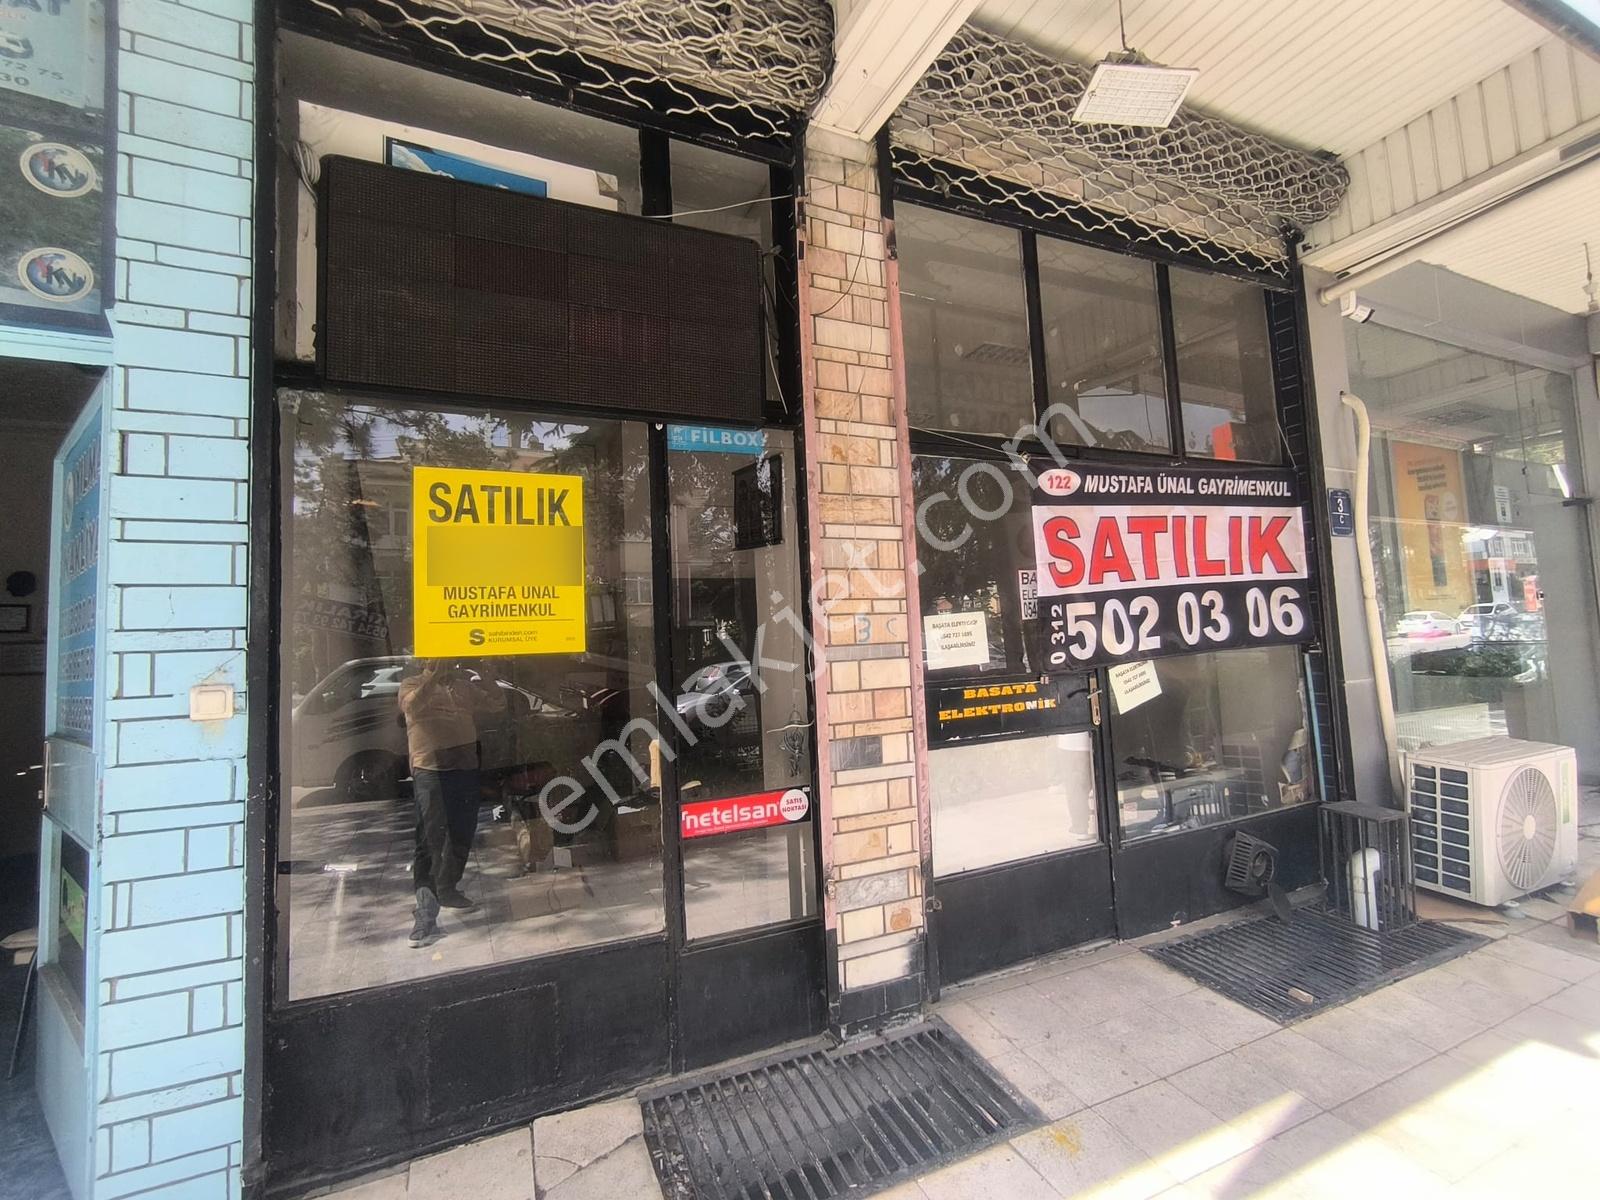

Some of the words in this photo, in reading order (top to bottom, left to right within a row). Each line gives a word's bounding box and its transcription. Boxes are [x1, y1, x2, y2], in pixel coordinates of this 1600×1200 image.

[1047, 475, 1072, 490] 122
[1084, 474, 1154, 494] MUSTAFA
[1156, 473, 1195, 495] ÜNAL
[1197, 476, 1292, 497] GAYRİMENKUL
[429, 482, 571, 526] SATILIK
[1337, 498, 1344, 513] 3
[1042, 516, 1298, 589] SATILIK
[443, 586, 517, 600] MUSTAFA
[448, 601, 556, 618] GAYRİMENKUL
[1066, 595, 1161, 661] 502
[1177, 590, 1231, 646] 03
[1245, 586, 1305, 638] 06
[938, 697, 1057, 721] ELEKTRONİK
